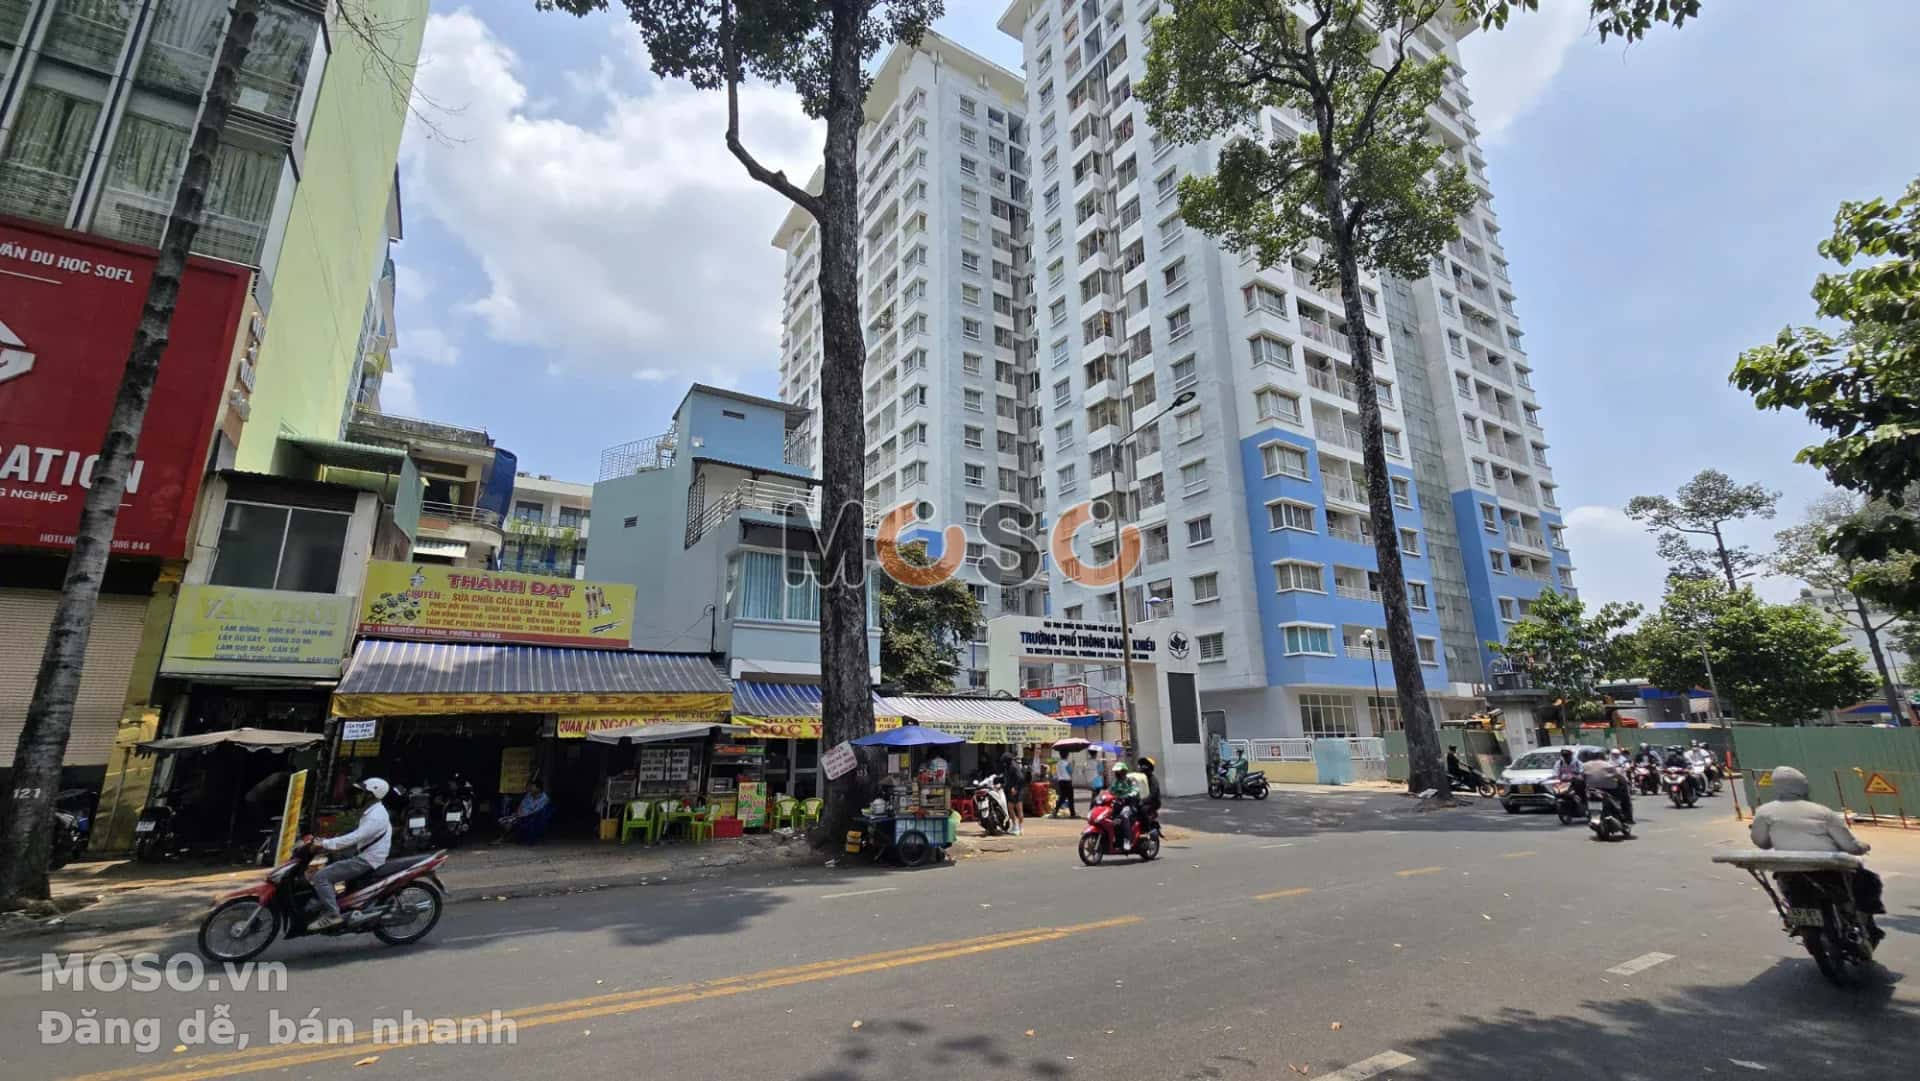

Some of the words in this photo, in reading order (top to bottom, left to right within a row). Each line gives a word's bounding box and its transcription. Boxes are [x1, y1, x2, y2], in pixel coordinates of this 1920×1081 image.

[30, 249, 55, 266] DU
[94, 264, 134, 284] SOFL
[0, 443, 145, 495] ATION
[10, 488, 69, 504] NGHIỆP
[40, 533, 78, 545] HOTLIN
[530, 580, 576, 601] ĐẠT
[1020, 629, 1057, 646] TRƯỜNG
[1077, 633, 1106, 649] THÔNG
[1107, 636, 1125, 650] NĂN
[1132, 636, 1156, 652] KHIẾU
